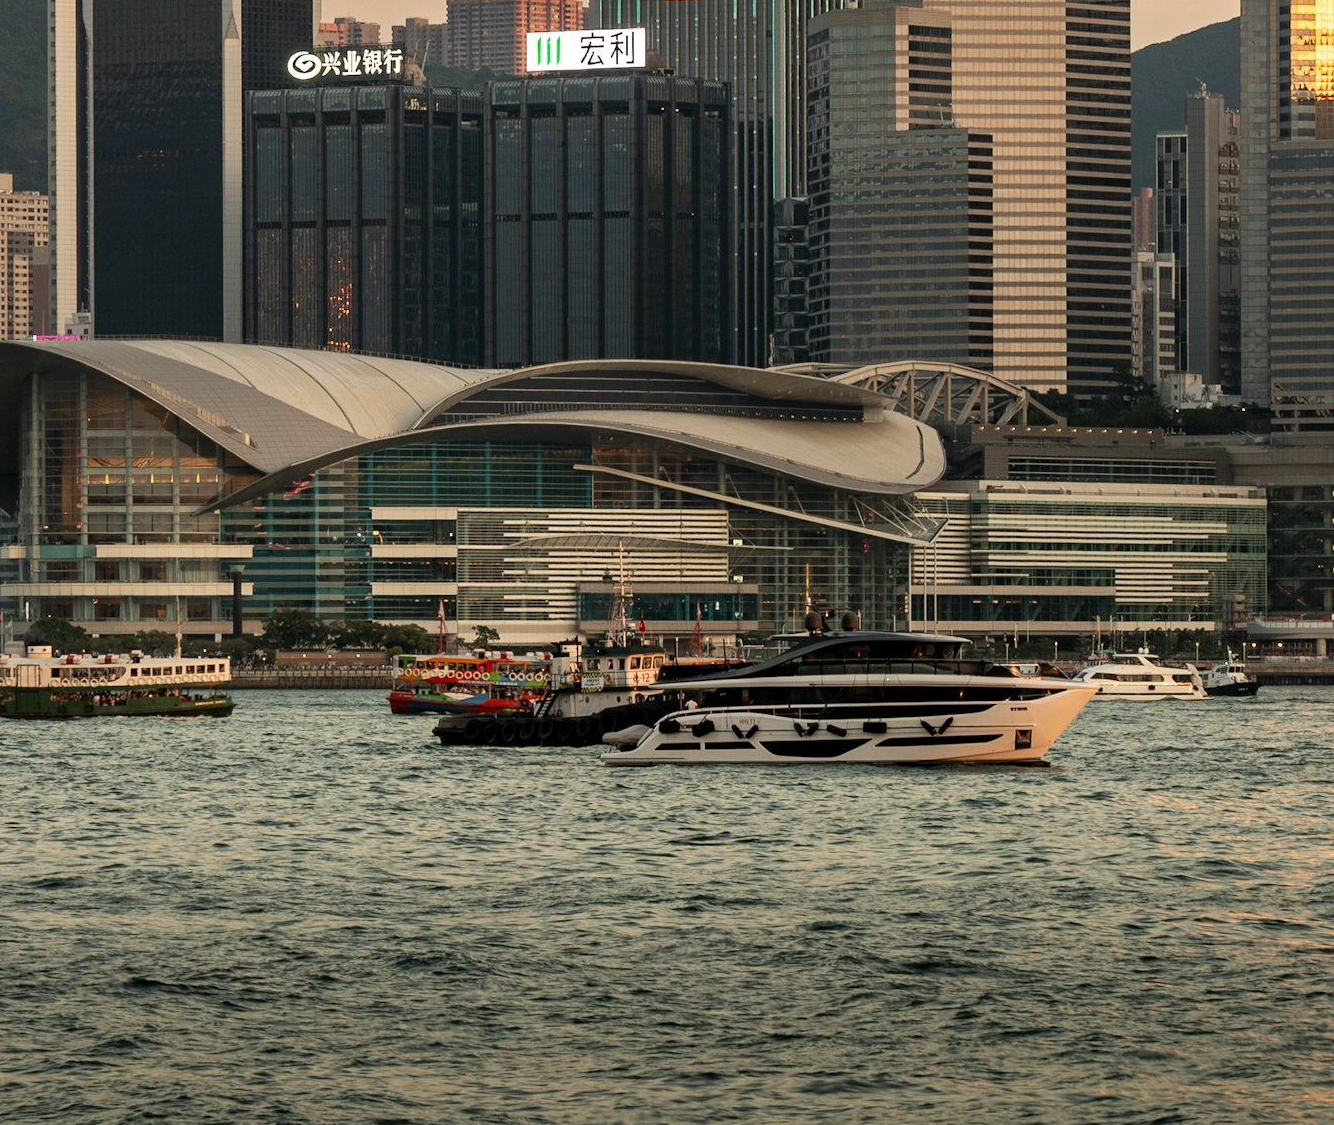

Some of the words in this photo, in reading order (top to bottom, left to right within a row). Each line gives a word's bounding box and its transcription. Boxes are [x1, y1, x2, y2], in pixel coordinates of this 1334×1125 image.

[581, 32, 635, 65] 宏利
[322, 49, 403, 76] 兴业银行
[641, 672, 650, 683] 12
